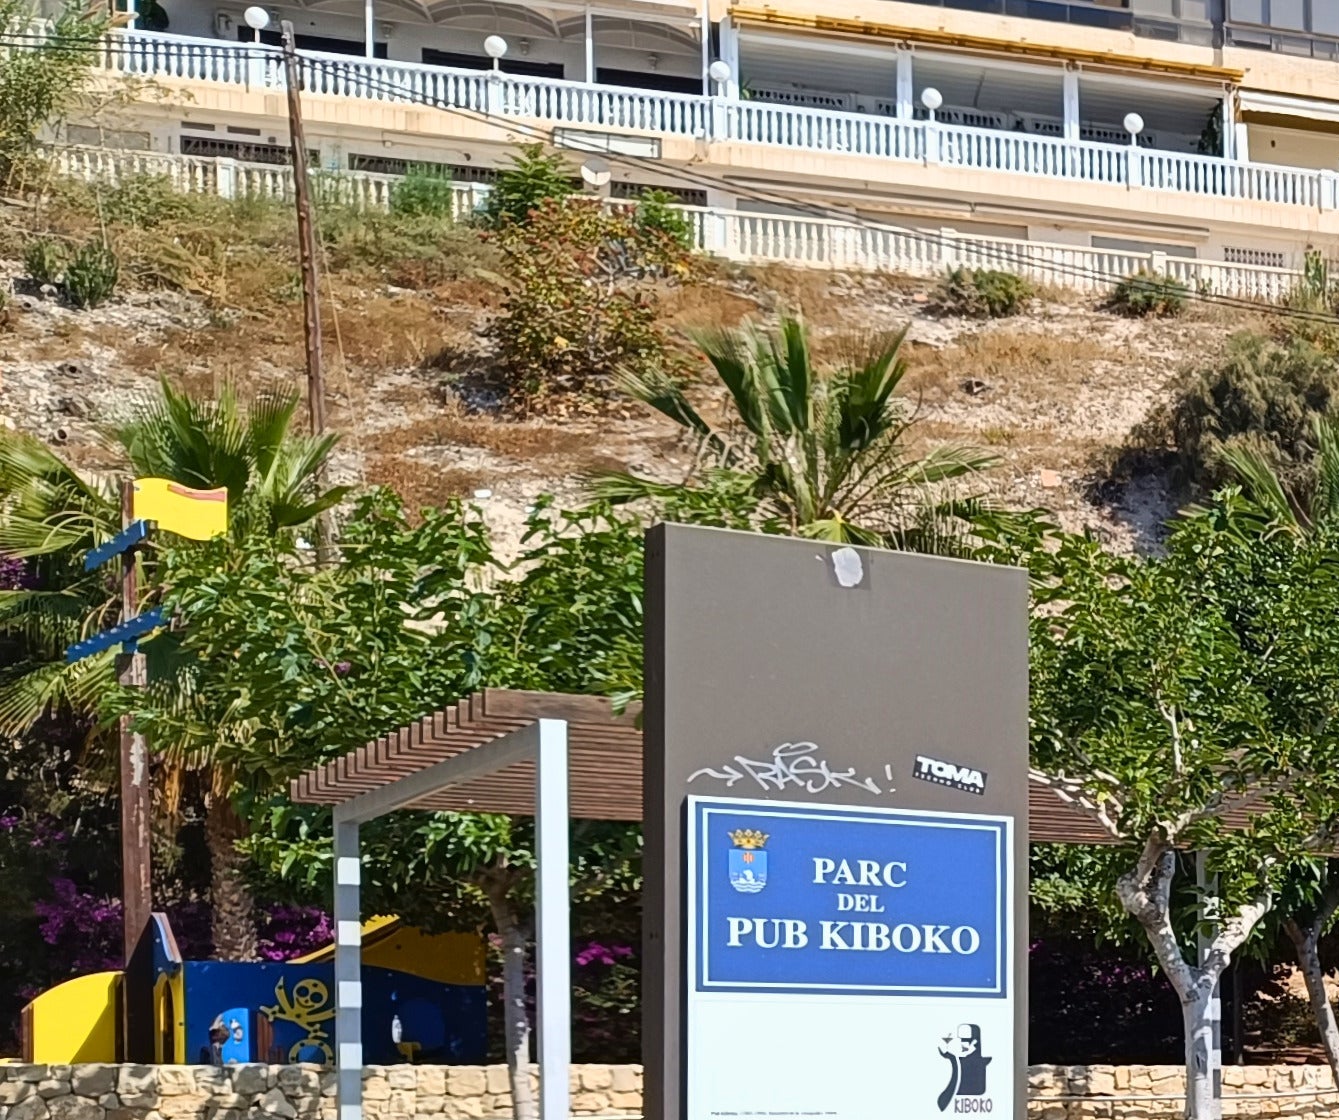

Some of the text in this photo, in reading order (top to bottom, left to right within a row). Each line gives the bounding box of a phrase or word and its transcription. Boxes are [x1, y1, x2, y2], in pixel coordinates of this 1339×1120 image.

[916, 755, 984, 788] TOMA
[812, 857, 907, 888] PARC
[837, 893, 885, 913] DEL
[726, 917, 981, 955] PUB KIBOKO
[954, 1098, 993, 1113] KIBOKO
